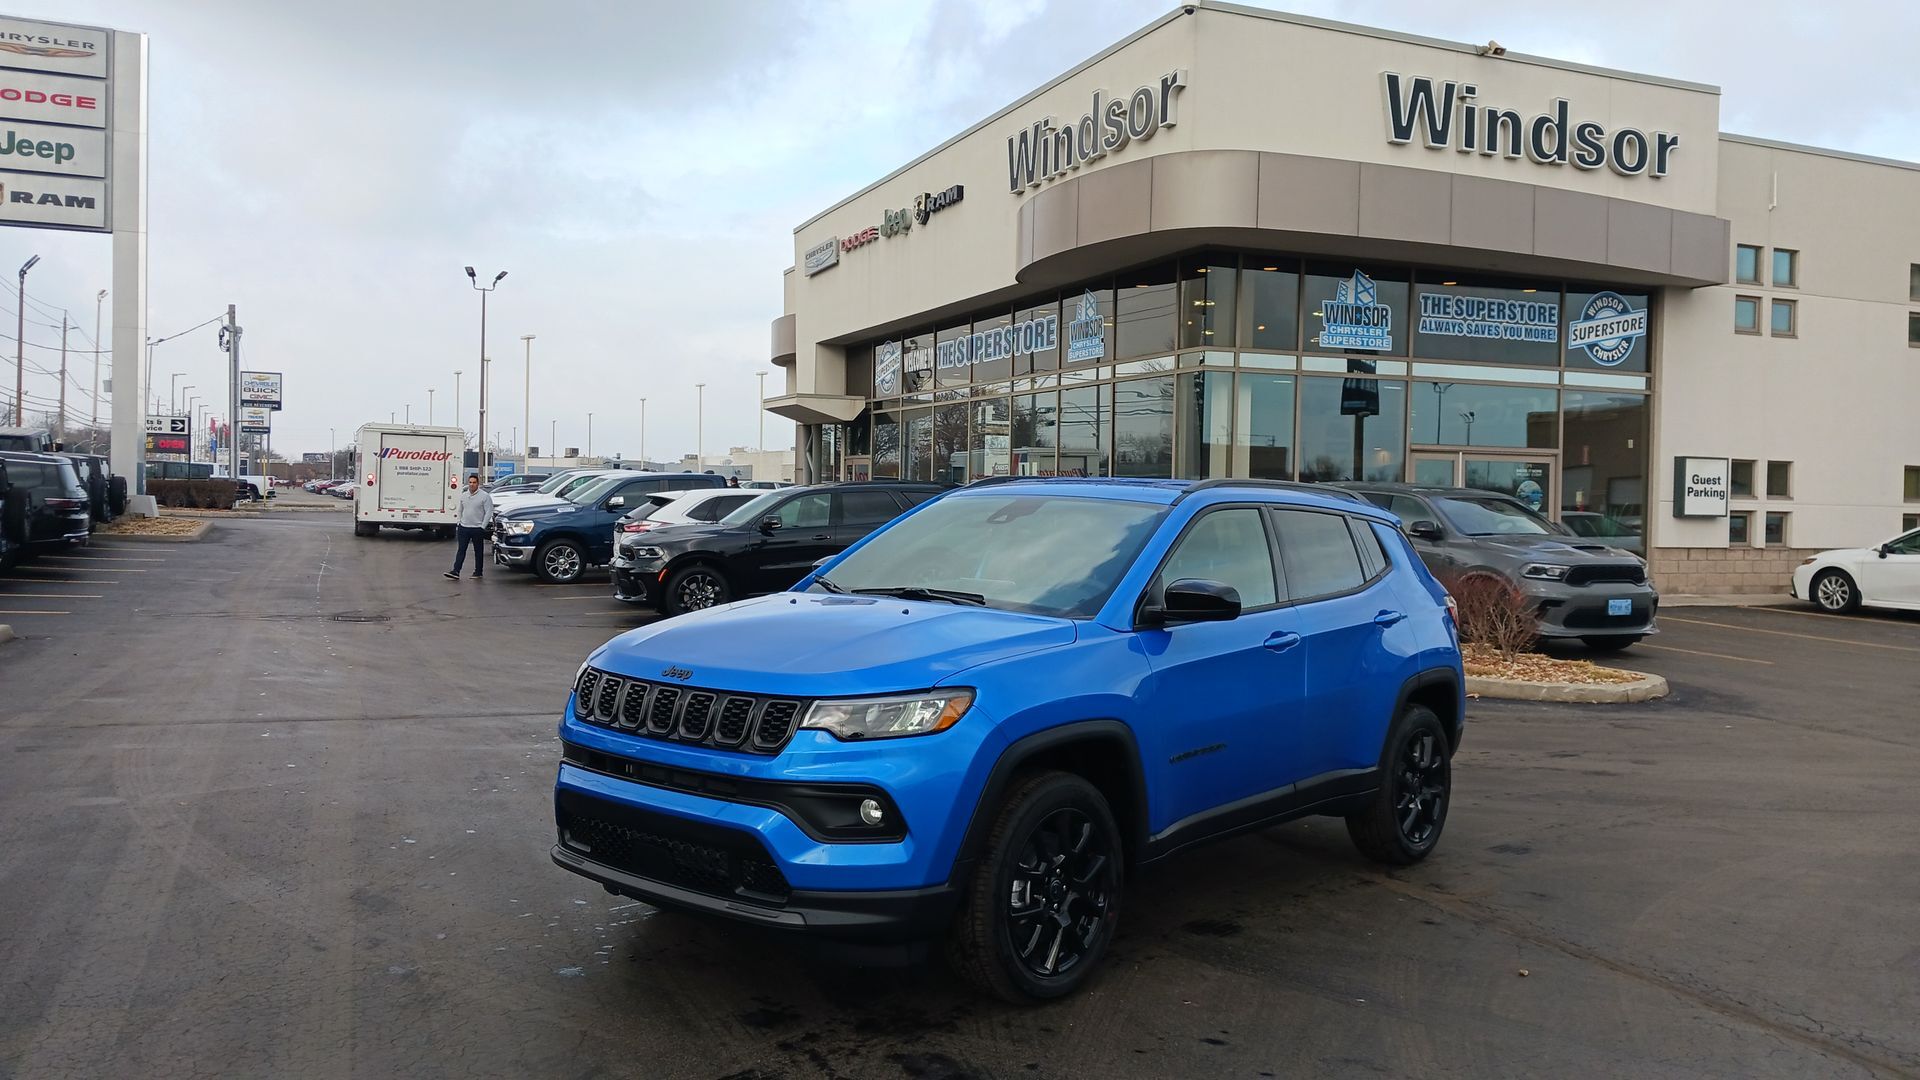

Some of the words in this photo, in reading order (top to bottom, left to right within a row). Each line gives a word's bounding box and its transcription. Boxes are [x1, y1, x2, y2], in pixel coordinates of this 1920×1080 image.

[0, 88, 96, 109] ODGE
[1007, 69, 1187, 195] Windsor
[1380, 71, 1680, 178] Windsor
[0, 131, 75, 164] Jeep
[10, 190, 95, 209] RAM
[926, 185, 964, 214] RAM
[880, 208, 912, 238] Jeep
[841, 226, 879, 252] DODGE
[805, 241, 834, 261] CHRYSLER
[1324, 303, 1389, 328] WINDSOR
[1421, 294, 1452, 316] THE
[1454, 297, 1557, 325] SUPERSTORE
[1587, 297, 1624, 316] WINDSOR
[1070, 317, 1103, 341] WINDSOR
[1329, 326, 1384, 337] CHRYSLER
[1420, 319, 1464, 335] ALWAYS
[1465, 321, 1500, 338] SAVES
[1502, 324, 1524, 340] YOU
[1524, 327, 1557, 341] MORE!
[1572, 317, 1644, 342] SUPERSTORE
[937, 341, 955, 369] THE
[955, 316, 1057, 367] SUPERSTORE
[1072, 338, 1100, 349] CHRYSLER
[1322, 336, 1390, 347] SUPERSTORE
[1592, 340, 1629, 361] CHRYSLER
[1069, 347, 1104, 360] SUPERSTORE
[387, 448, 453, 461] Purolator
[1692, 474, 1721, 485] Guest
[1687, 487, 1726, 500] Parking
[661, 665, 693, 681] Jeep
